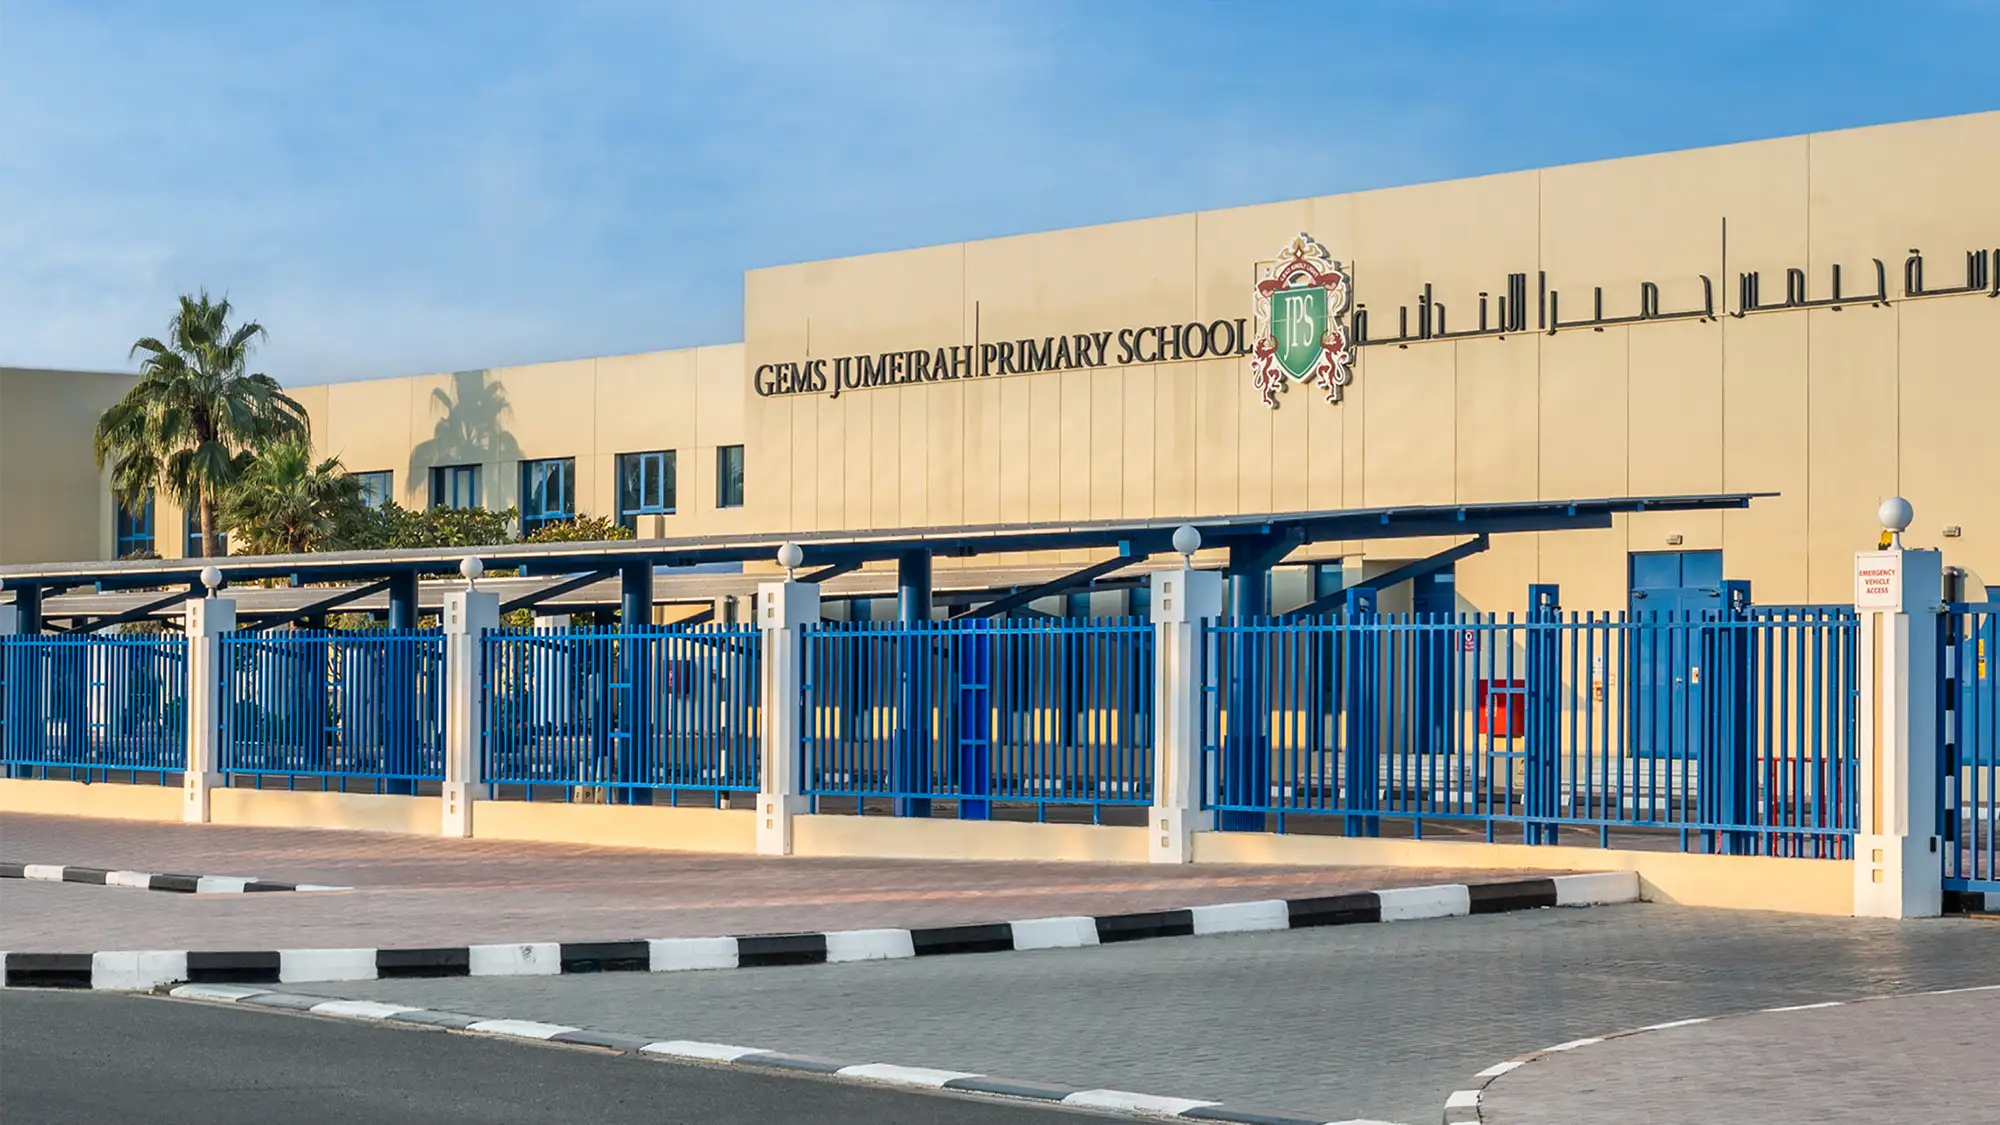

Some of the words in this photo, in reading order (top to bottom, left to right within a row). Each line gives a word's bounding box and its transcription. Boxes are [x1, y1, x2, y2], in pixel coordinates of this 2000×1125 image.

[1284, 294, 1314, 361] JPS
[1536, 270, 1717, 335] جميرا
[754, 358, 827, 397] GEMS
[830, 345, 974, 399] JUMEIRAH
[980, 331, 1113, 377] PRIMARY
[1117, 318, 1253, 365] SCHOOL
[1859, 569, 1896, 577] EMERGENCY
[1865, 578, 1890, 586] VEHICLE
